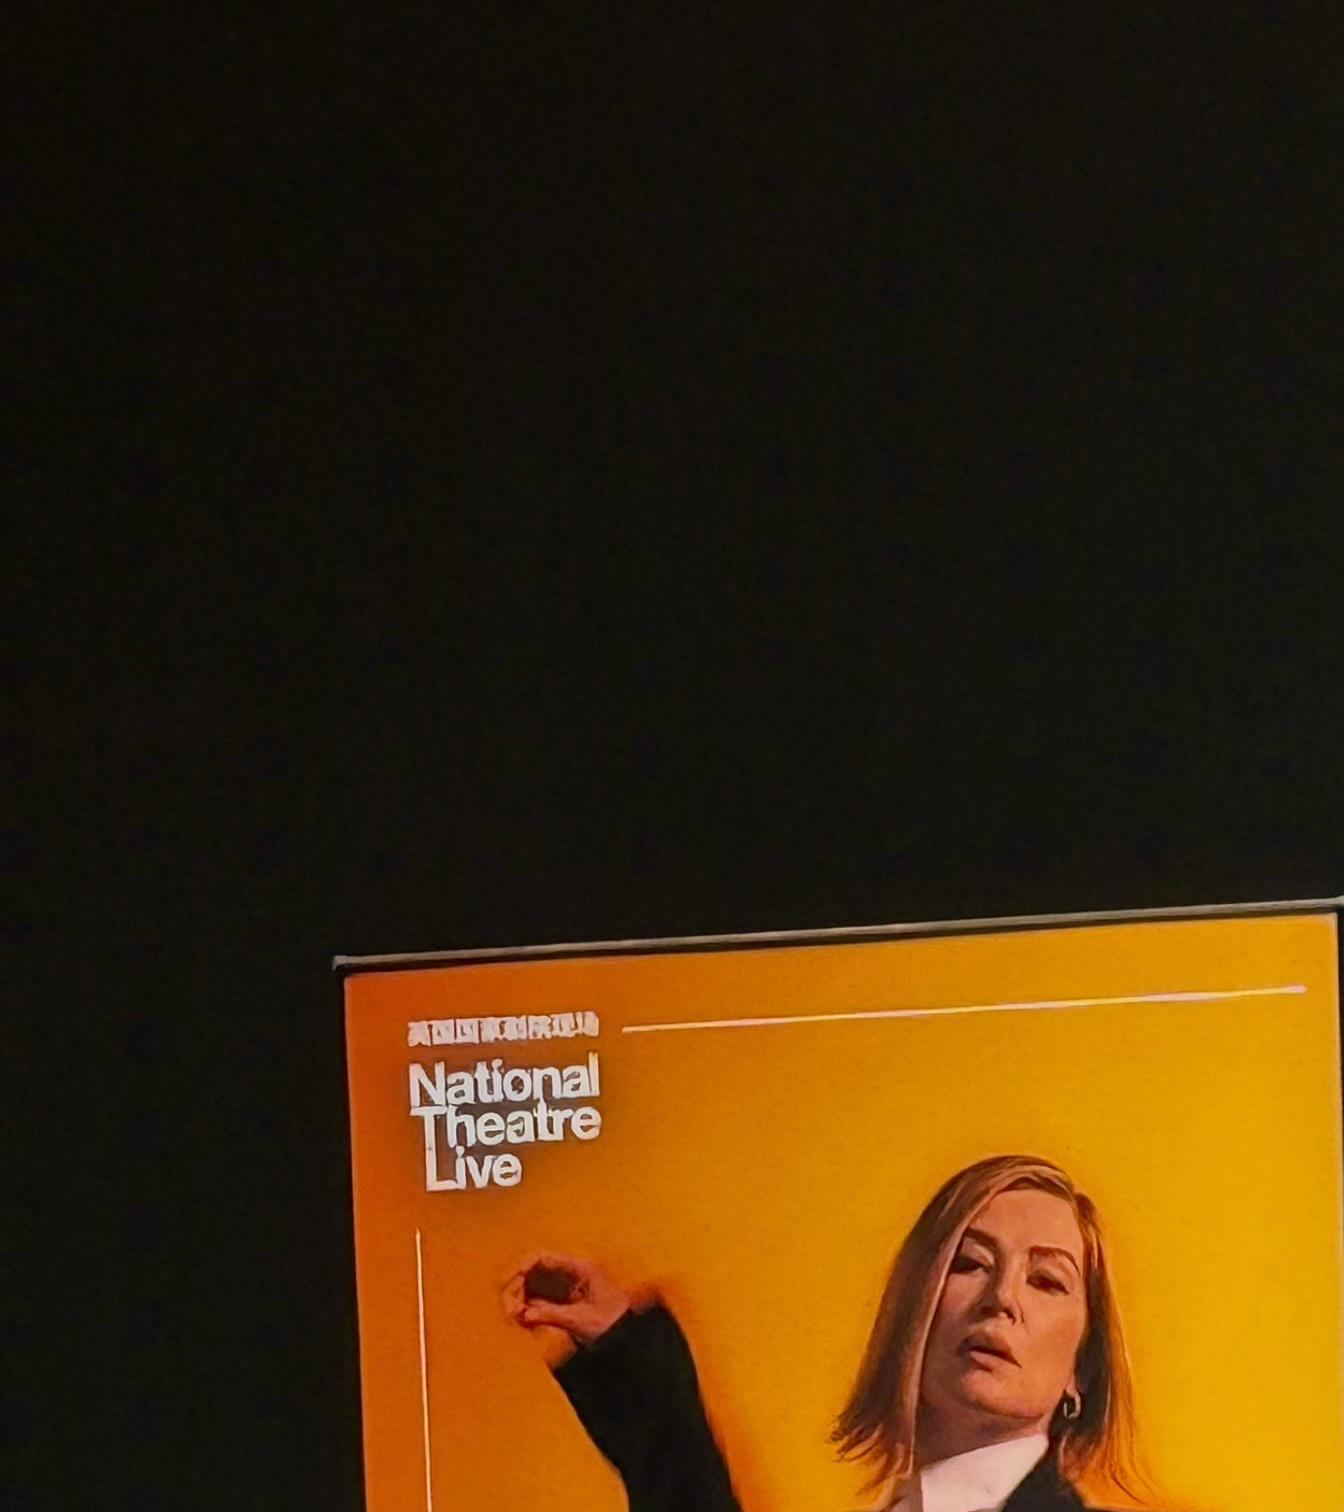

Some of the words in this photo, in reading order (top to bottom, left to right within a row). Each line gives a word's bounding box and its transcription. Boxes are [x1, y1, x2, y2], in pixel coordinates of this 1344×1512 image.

[409, 1051, 600, 1106] National
[409, 1098, 602, 1148] Theatre
[425, 1146, 522, 1191] Live
